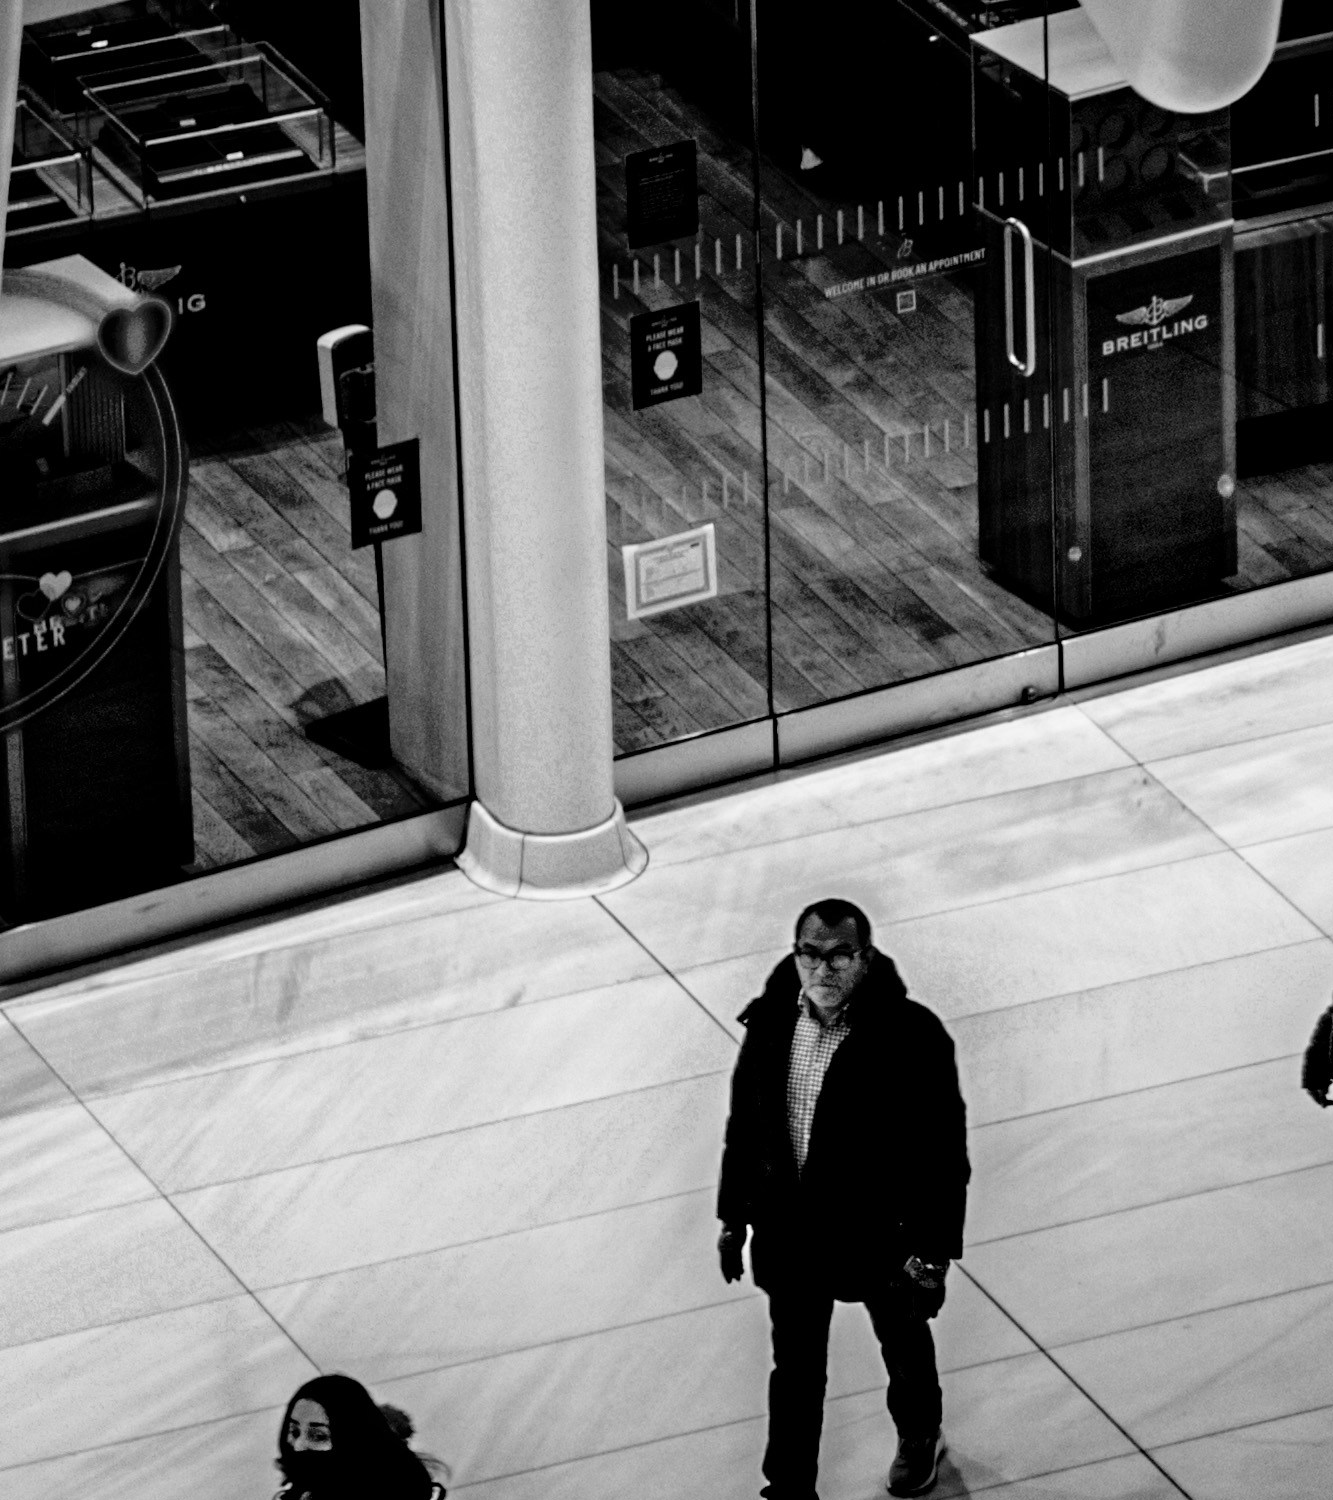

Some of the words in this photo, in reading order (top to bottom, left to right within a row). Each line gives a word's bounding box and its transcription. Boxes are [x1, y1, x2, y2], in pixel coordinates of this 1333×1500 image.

[824, 278, 864, 298] WELCOME
[866, 275, 876, 287] IN
[877, 272, 889, 285] OR
[891, 267, 915, 281] BOOK
[915, 262, 927, 275] AN
[928, 248, 986, 272] APPOINTMENT
[645, 330, 666, 342] PLEASE
[667, 326, 684, 337] WEAR
[1102, 314, 1208, 356] BREITLING
[648, 344, 652, 352] A
[652, 341, 666, 351] FACE
[667, 337, 682, 347] MASK
[650, 385, 668, 396] THANK
[364, 468, 385, 481] PLEASE
[386, 464, 403, 475] WEAR
[366, 483, 371, 491] A
[370, 479, 385, 489] FACE
[386, 474, 402, 486] MASK
[369, 524, 388, 535] THANK
